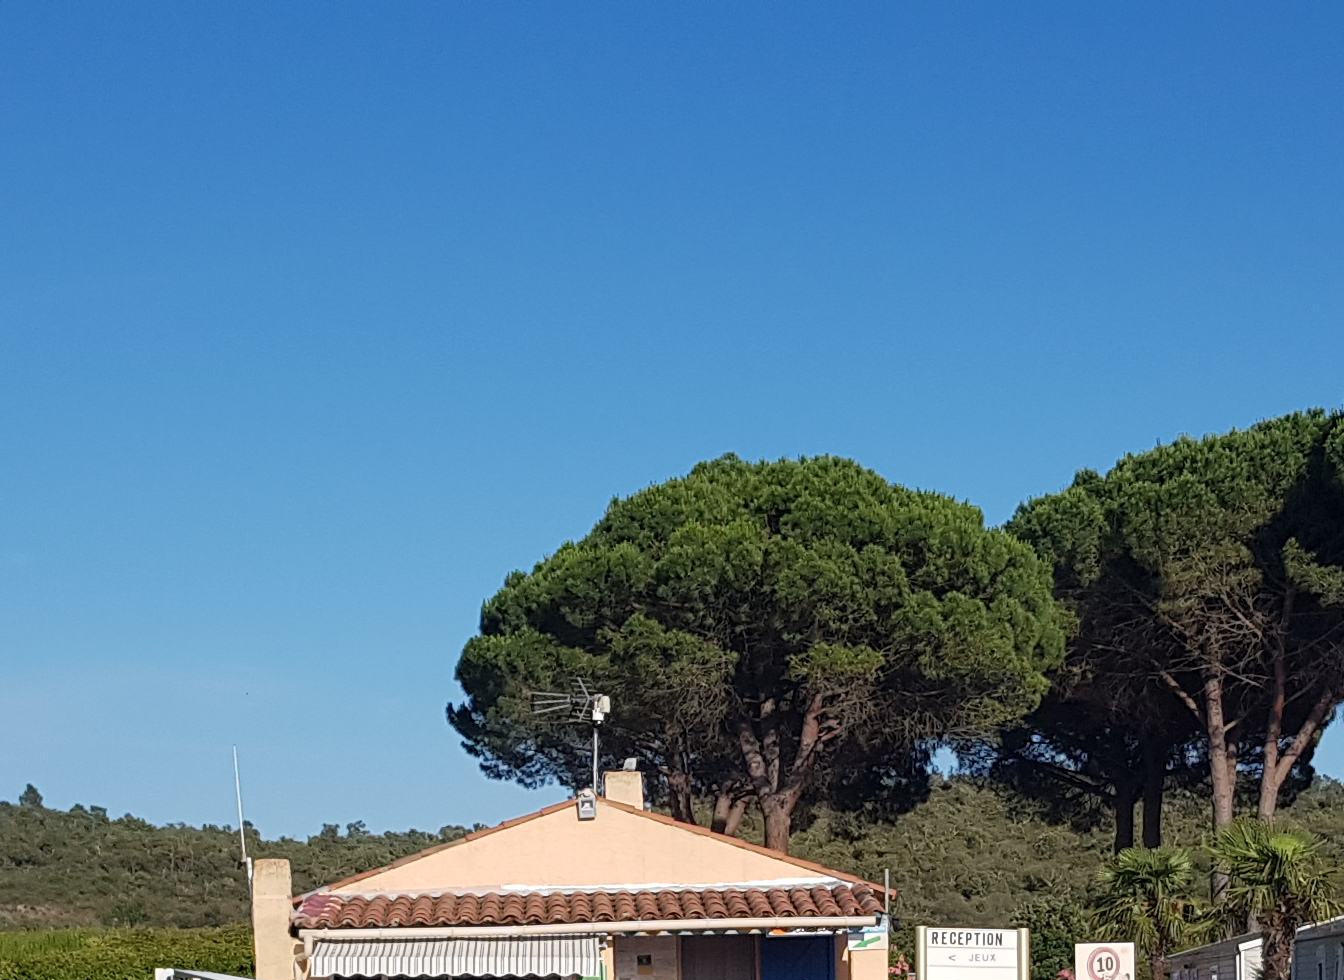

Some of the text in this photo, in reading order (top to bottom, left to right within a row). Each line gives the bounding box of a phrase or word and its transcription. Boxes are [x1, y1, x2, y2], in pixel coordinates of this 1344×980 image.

[931, 931, 1003, 946] RECEPTION
[968, 953, 996, 962] JEUX
[1096, 956, 1114, 973] 10
